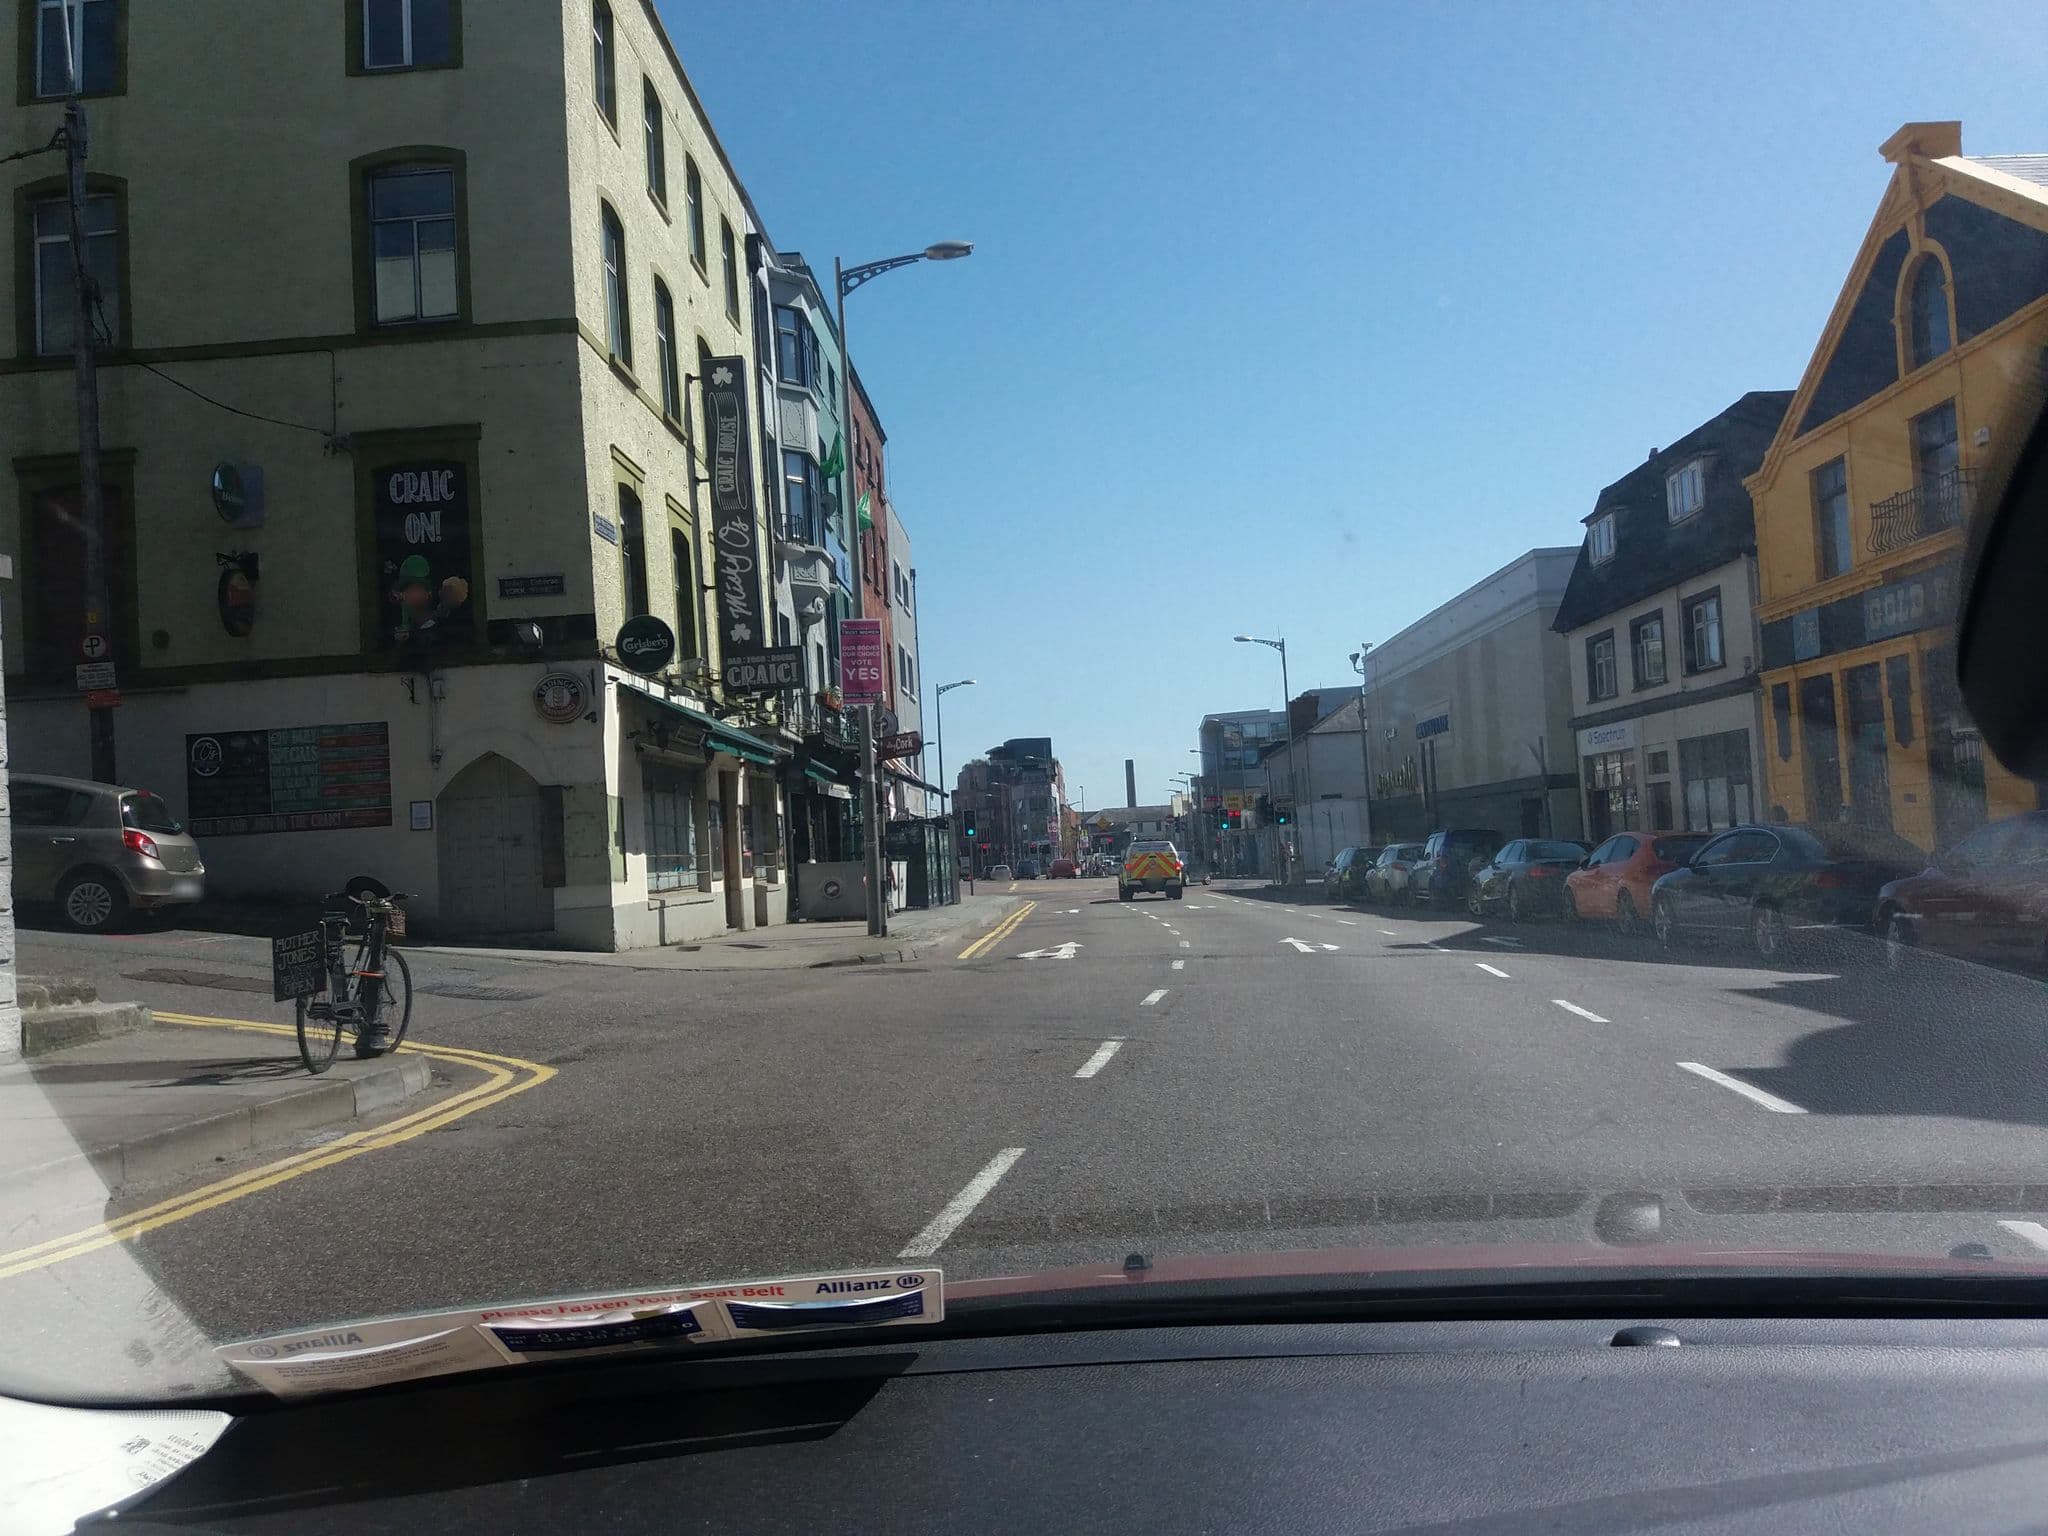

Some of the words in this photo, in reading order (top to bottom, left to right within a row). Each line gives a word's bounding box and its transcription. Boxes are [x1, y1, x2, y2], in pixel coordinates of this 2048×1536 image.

[719, 415, 738, 453] HOUSE
[389, 469, 456, 504] CRAIC
[718, 456, 736, 493] CRAIC
[404, 510, 443, 544] ON!
[1869, 583, 1925, 630] GOLD
[622, 636, 669, 653] Carlsberg
[727, 662, 799, 687] CRAIC!
[846, 667, 880, 681] YES
[275, 930, 320, 952] MOTHER
[278, 947, 317, 970] JONES
[815, 1278, 892, 1294] Allianz
[480, 1307, 553, 1321] Please
[556, 1299, 629, 1315] Fasten
[689, 1288, 737, 1299] Seat
[742, 1285, 785, 1297] Belt
